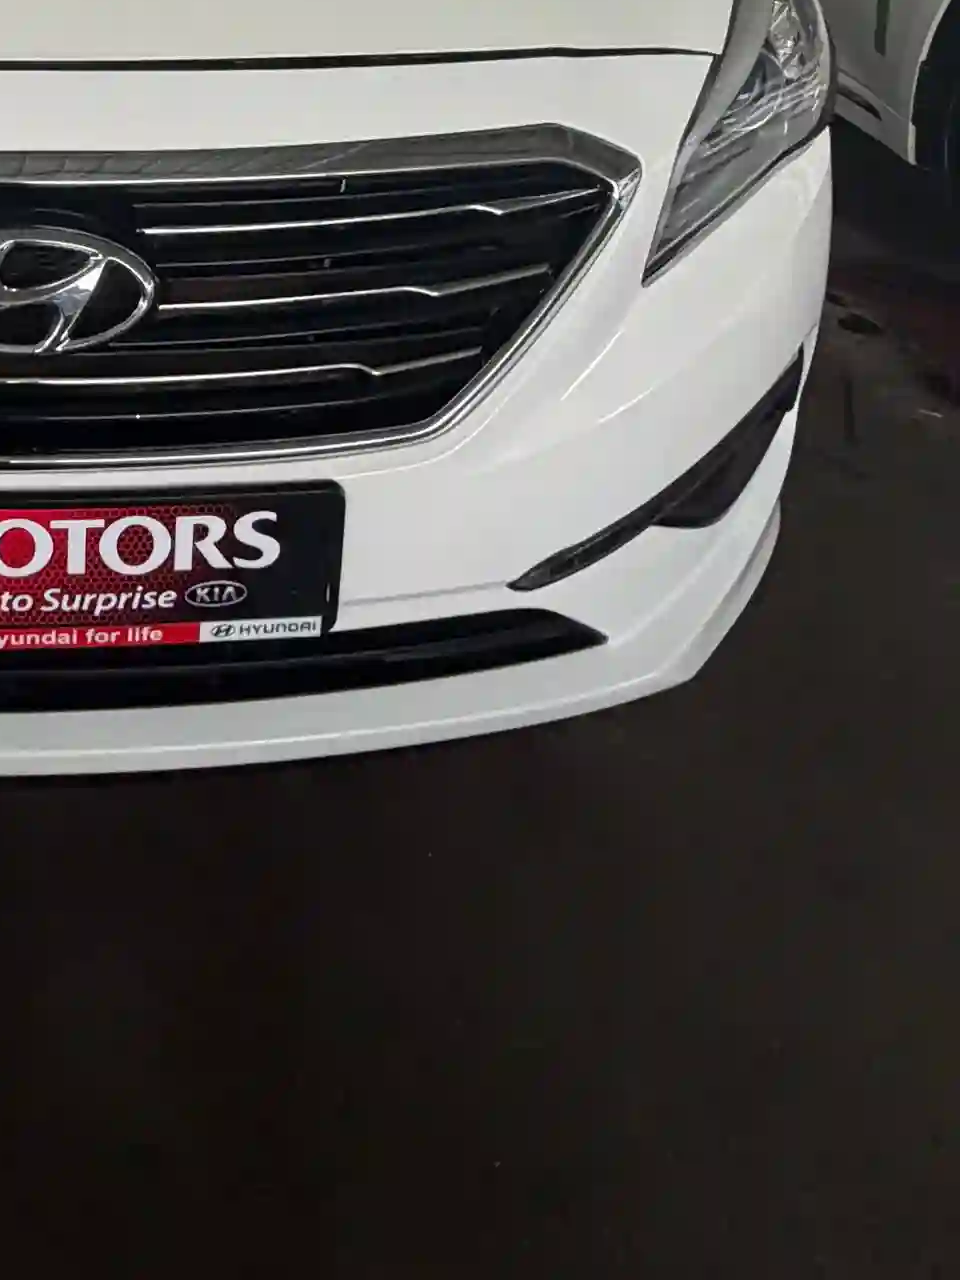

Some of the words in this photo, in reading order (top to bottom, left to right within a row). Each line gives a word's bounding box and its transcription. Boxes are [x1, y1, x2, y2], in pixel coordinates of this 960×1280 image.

[0, 590, 34, 612] to
[40, 586, 177, 616] Surprise
[85, 627, 120, 643] for
[127, 626, 163, 642] life
[239, 621, 317, 636] HYUNDAI
